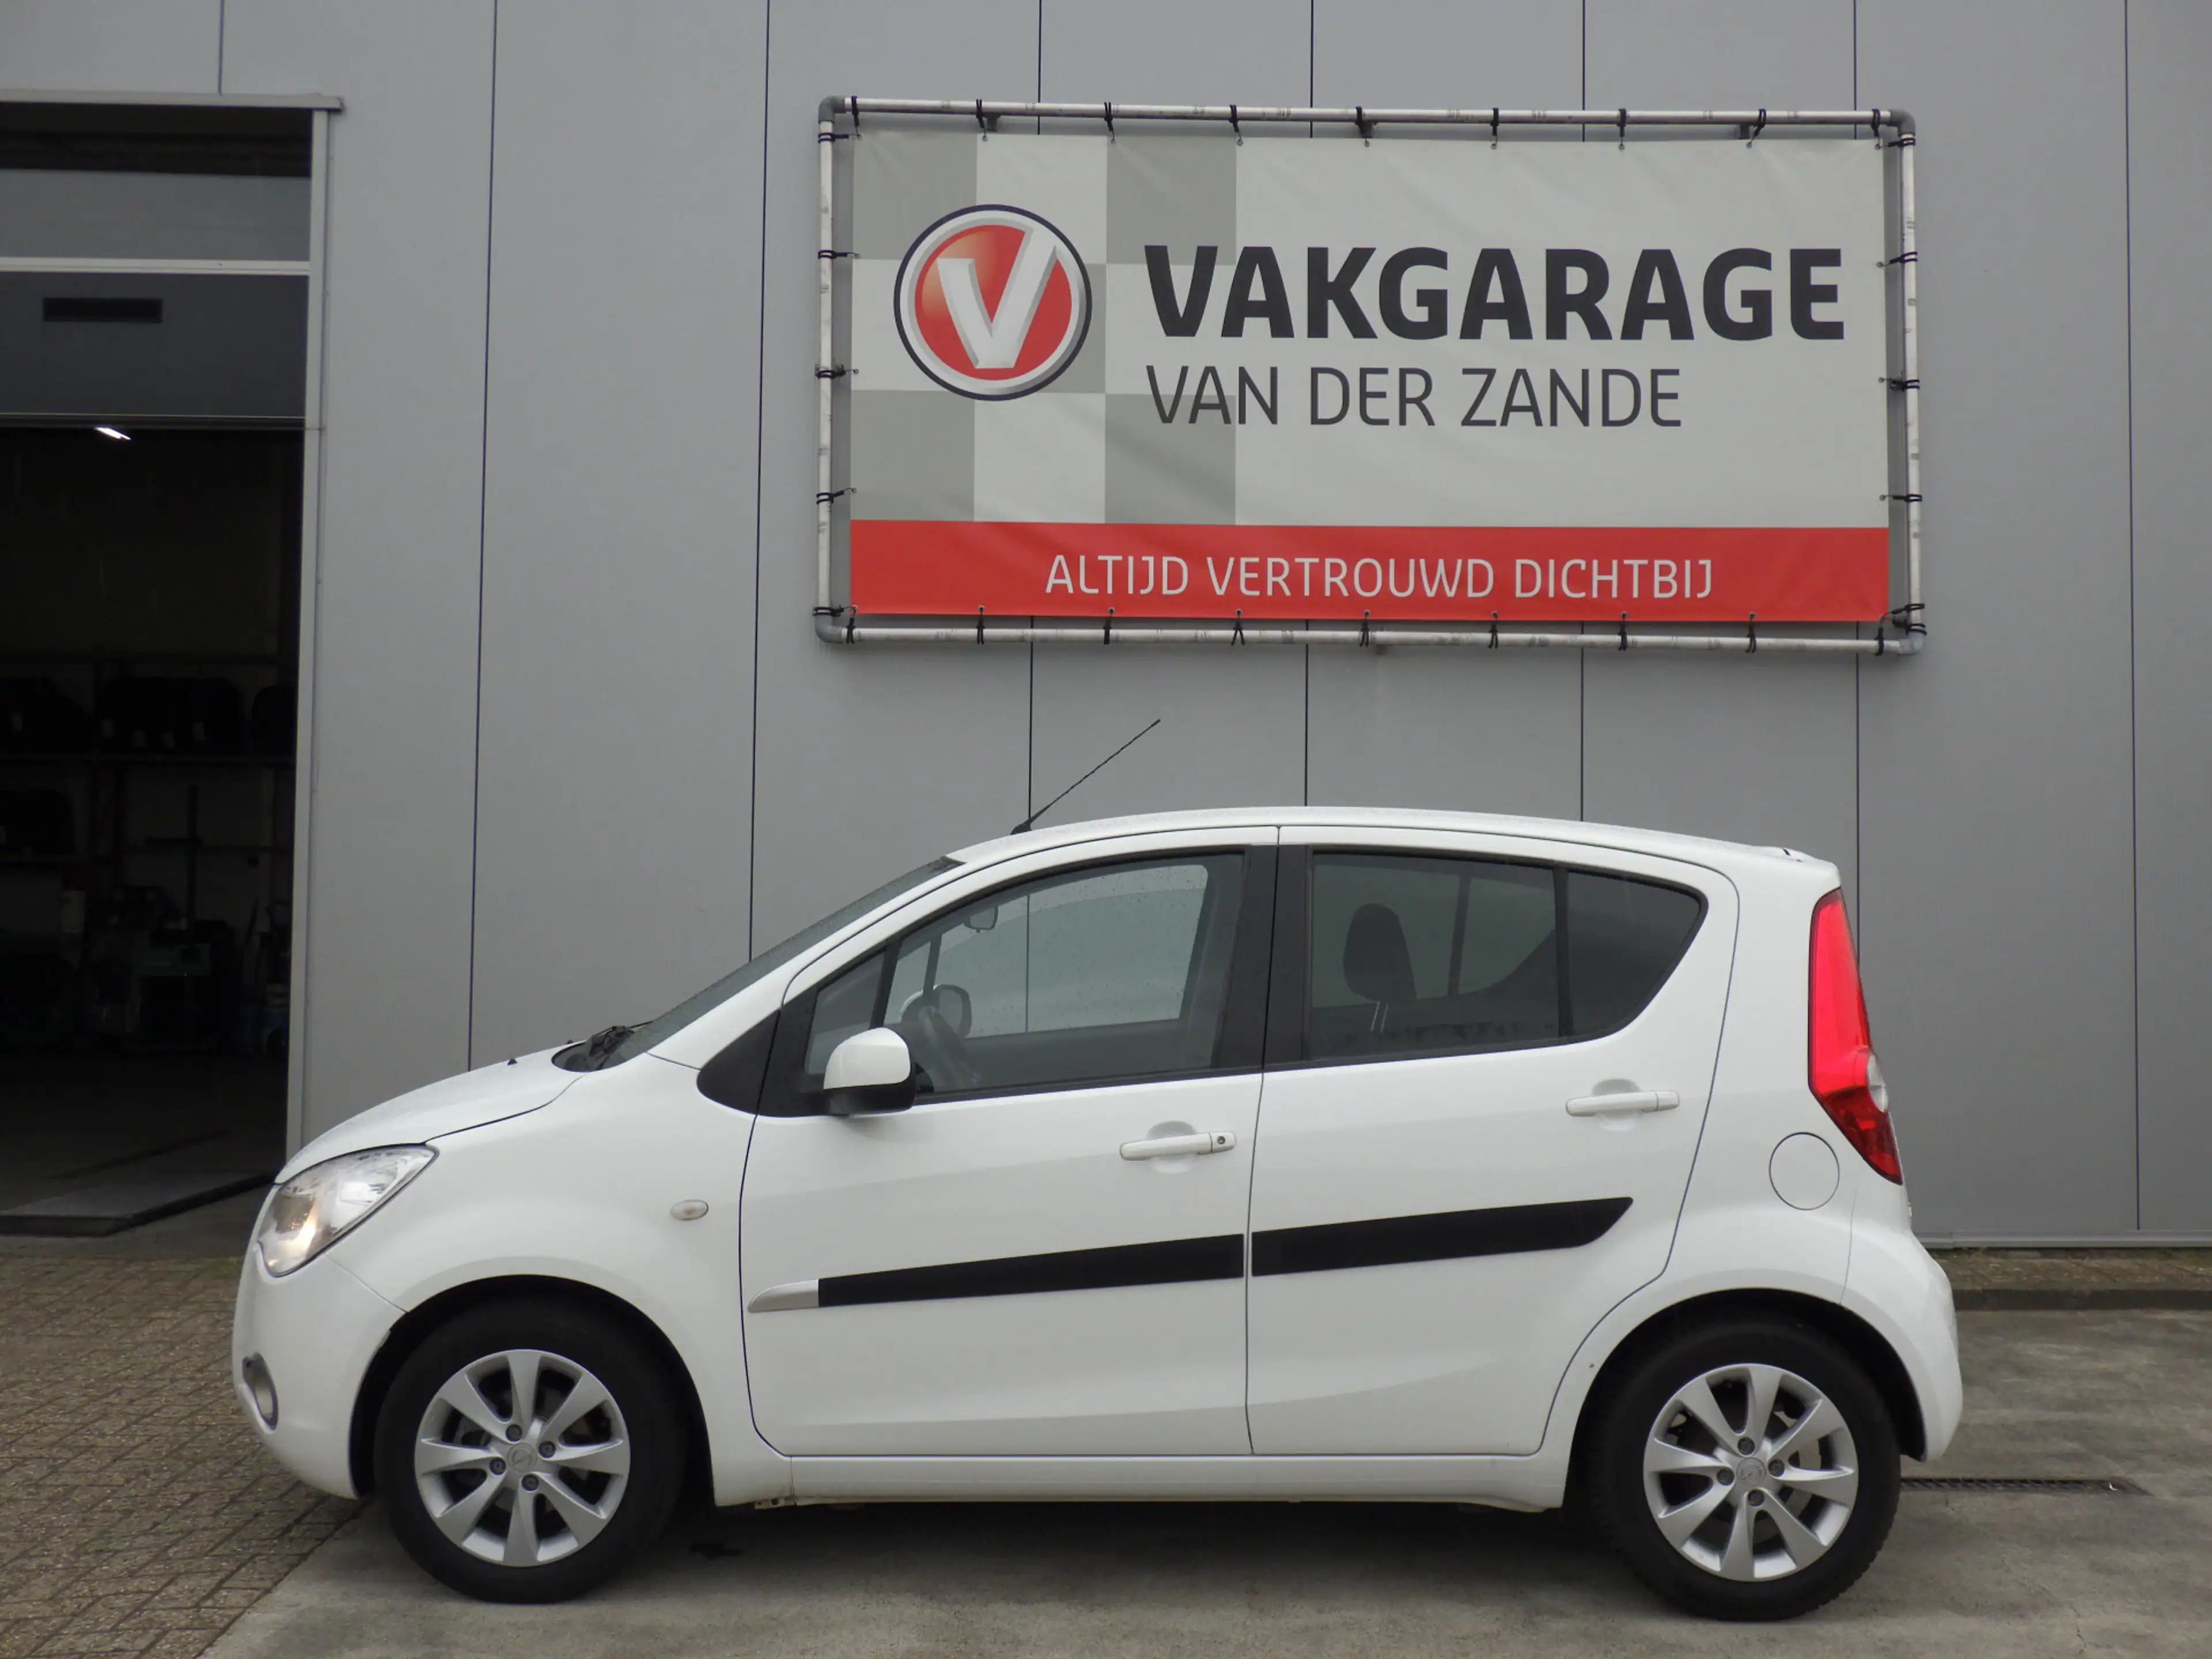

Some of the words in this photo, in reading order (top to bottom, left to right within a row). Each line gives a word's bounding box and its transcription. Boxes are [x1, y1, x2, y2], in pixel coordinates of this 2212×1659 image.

[935, 227, 1058, 370] V
[1143, 244, 1844, 341] VAKGARAGE
[1146, 365, 1278, 425] VAN
[1310, 367, 1435, 426] DER
[1461, 368, 1682, 427] ZANDE
[1045, 554, 1189, 596] ALTIJD
[1206, 556, 1495, 599] VERTROUWD
[1514, 558, 1713, 599] DICHTBIJ
